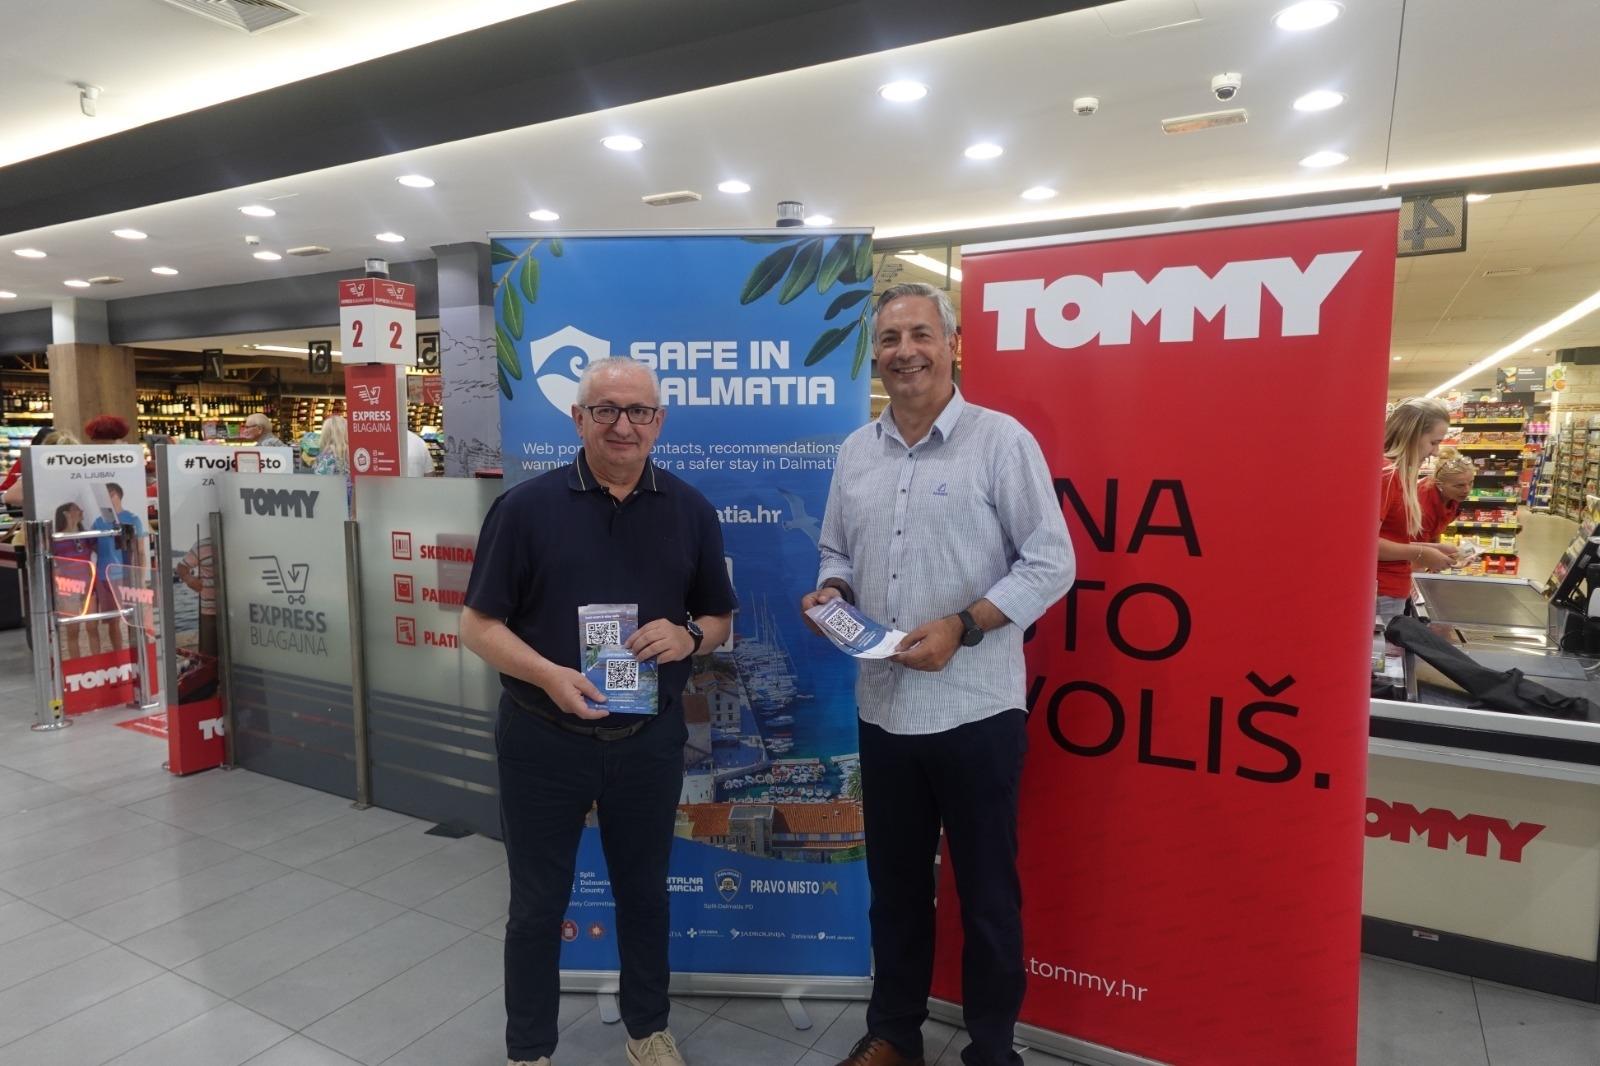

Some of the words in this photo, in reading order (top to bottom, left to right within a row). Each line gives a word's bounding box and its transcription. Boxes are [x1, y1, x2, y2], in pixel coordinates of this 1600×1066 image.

[983, 250, 1362, 351] TOMMY
[352, 320, 363, 347] 2
[389, 321, 402, 349] 2
[630, 341, 738, 370] SAFE
[750, 341, 790, 369] IN
[659, 377, 835, 405] ALMATIA
[352, 411, 391, 421] EXPRESS
[353, 422, 392, 433] BLAGAJNA
[47, 454, 134, 466] #TvojeMisto
[523, 442, 554, 455] Web
[558, 442, 582, 458] por
[650, 441, 706, 456] ontacts,
[709, 441, 841, 454] recommendations
[185, 456, 281, 471] #Tvojsto
[521, 457, 572, 470] warnin
[653, 458, 671, 470] for
[676, 461, 685, 470] a
[689, 457, 725, 470] safer
[729, 459, 759, 472] stay
[763, 457, 775, 470] in
[780, 457, 836, 470] Dalmati
[202, 478, 215, 486] ZA
[240, 488, 320, 518] TOMMY
[716, 505, 782, 523] atia.hr
[1054, 478, 1202, 557] NA
[420, 545, 475, 562] SKENIRA
[249, 603, 327, 633] EXPRESS
[1023, 580, 1191, 661] TO
[250, 625, 328, 656] BLAGAJNA
[424, 631, 458, 648] PLATI
[1026, 671, 1330, 789] OLIŠ.
[1365, 797, 1547, 863] OMMY
[667, 876, 703, 884] ITALNA
[751, 880, 785, 893] PRAVO
[788, 881, 819, 894] MISTO
[1023, 957, 1148, 1001] .tommy.hr
